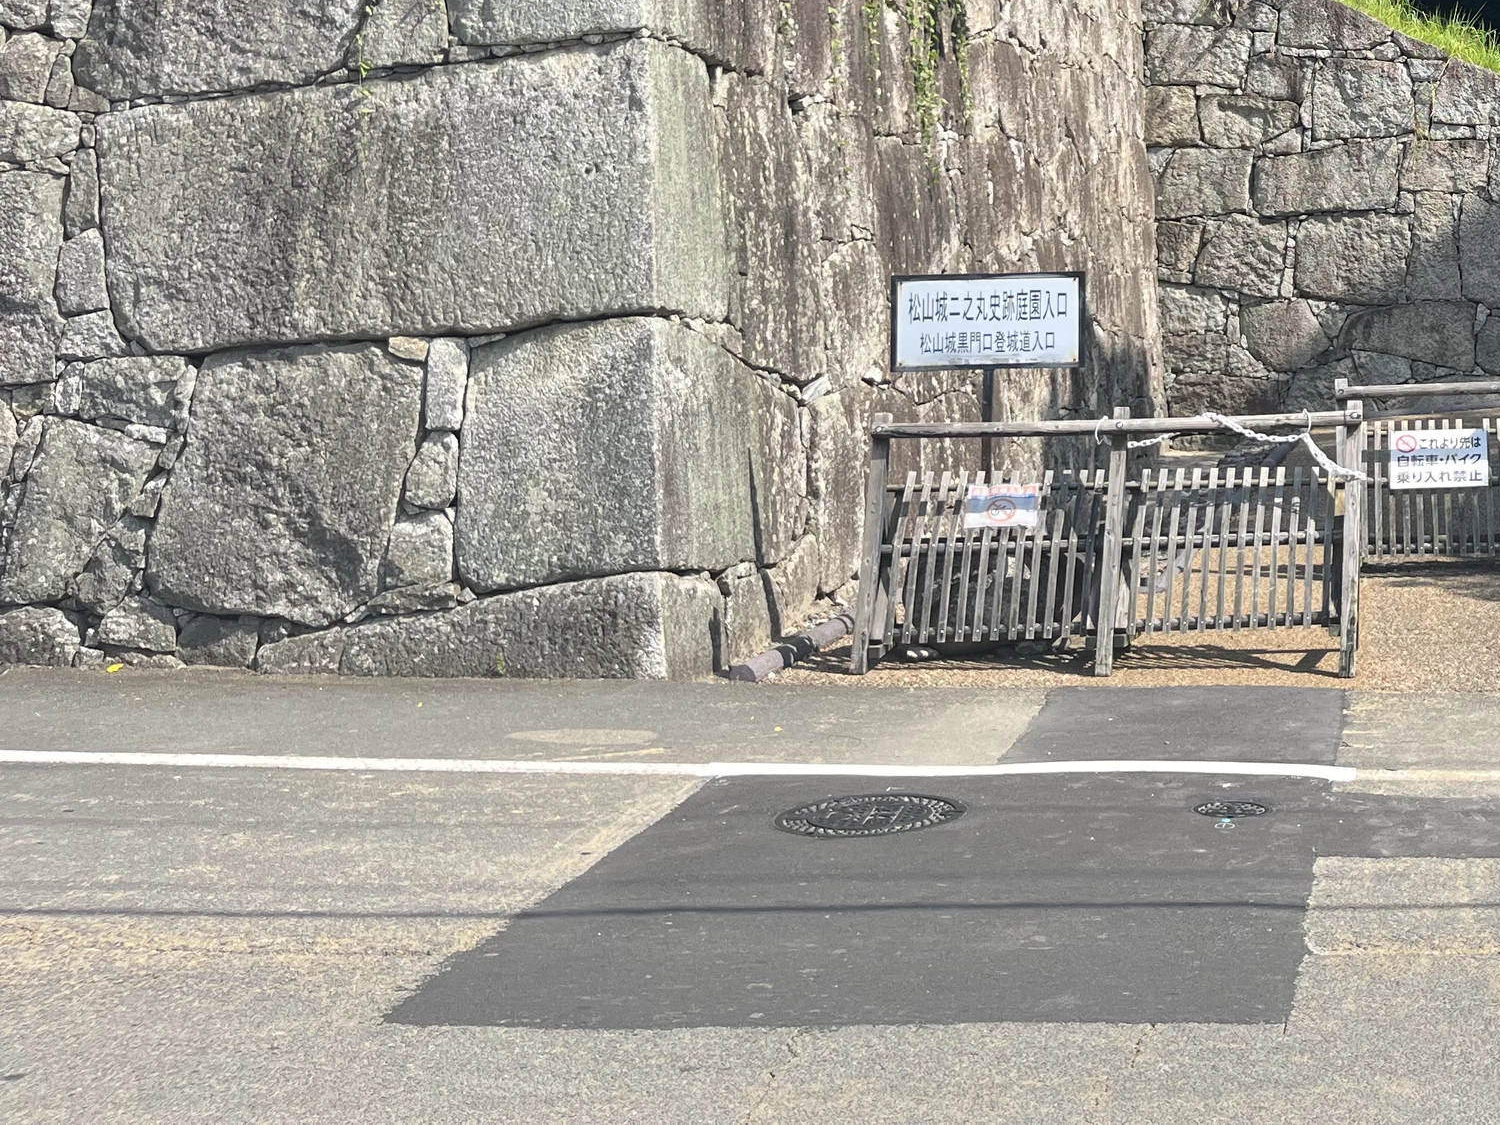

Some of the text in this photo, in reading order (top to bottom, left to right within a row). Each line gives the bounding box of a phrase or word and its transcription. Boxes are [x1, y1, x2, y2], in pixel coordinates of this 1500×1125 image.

[908, 289, 1068, 323] 松山城二之丸史跡庭園入口
[920, 330, 1055, 355] 松山城黒門口登城道入口
[1418, 436, 1481, 450] これより先は
[1397, 453, 1482, 467] 自転車・バイク
[1396, 470, 1483, 484] 乗り入れ禁止
